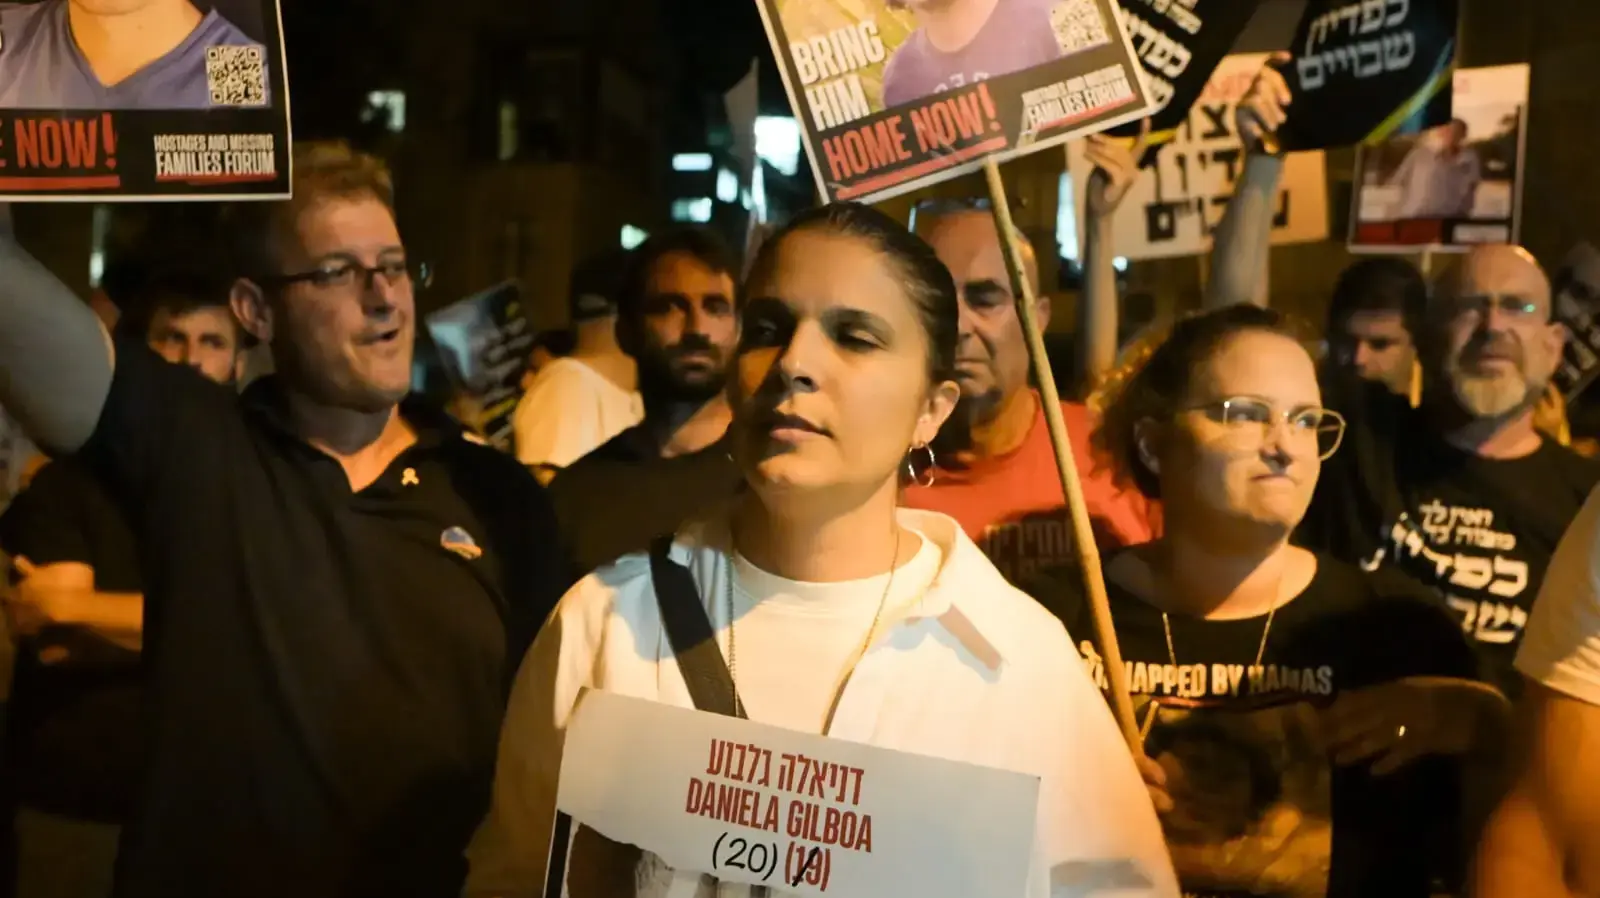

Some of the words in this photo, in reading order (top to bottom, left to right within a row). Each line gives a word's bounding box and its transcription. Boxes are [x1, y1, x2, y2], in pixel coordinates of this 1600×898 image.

[790, 20, 886, 85] BRING
[1297, 30, 1415, 91] שבויים
[804, 74, 871, 132] HIM
[14, 112, 118, 170] NOW!
[153, 134, 206, 152] HOSTAGES
[207, 133, 229, 151] AND
[822, 115, 913, 181] HOME
[910, 82, 1002, 153] NOW!
[156, 150, 222, 176] FAMILIES
[223, 150, 275, 176] FORUM
[1211, 663, 1244, 698] BY
[705, 738, 773, 787] גלבוע
[777, 752, 865, 806] דניאלה
[685, 777, 780, 834] DANIELA
[786, 800, 872, 853] GILBOA
[712, 831, 778, 881] (20)
